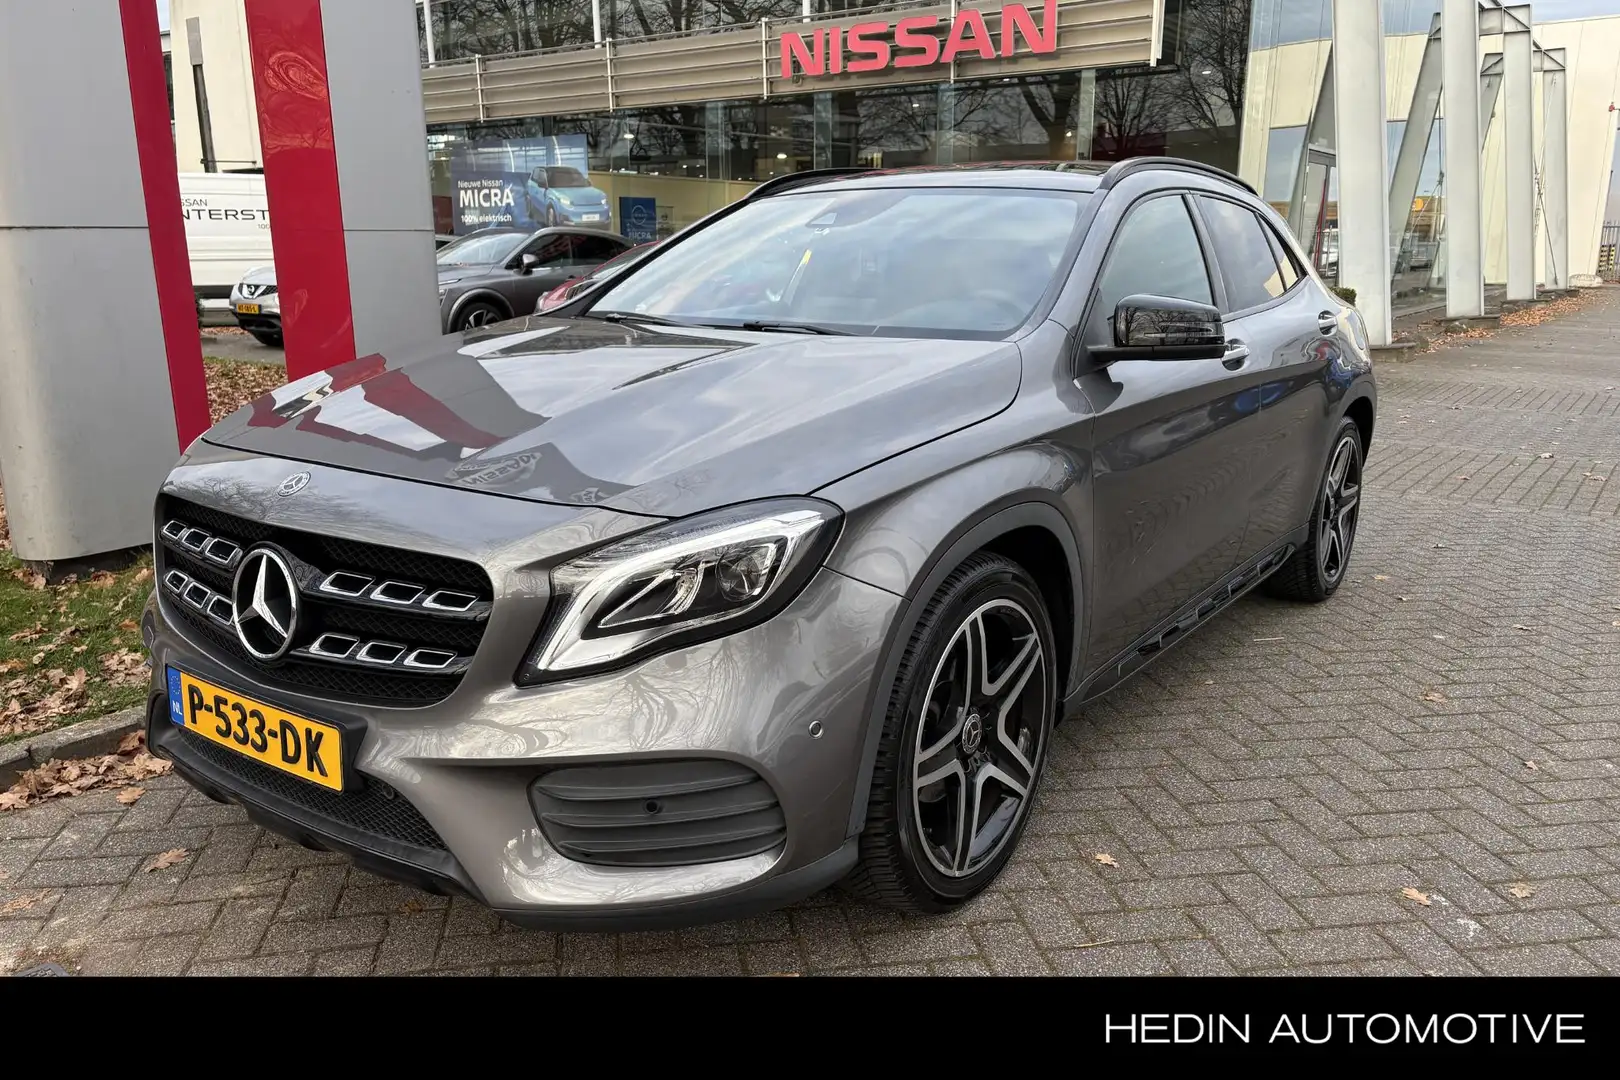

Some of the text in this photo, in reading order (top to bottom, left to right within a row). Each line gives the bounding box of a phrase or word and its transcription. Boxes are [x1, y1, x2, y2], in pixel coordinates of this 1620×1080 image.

[781, 0, 1057, 79] NISSAN
[457, 179, 503, 188] Nieuwe Nissan
[460, 188, 514, 208] MICRA
[461, 213, 512, 223] 100% elektrisch
[172, 700, 183, 716] NL
[187, 683, 329, 778] P-533-DK
